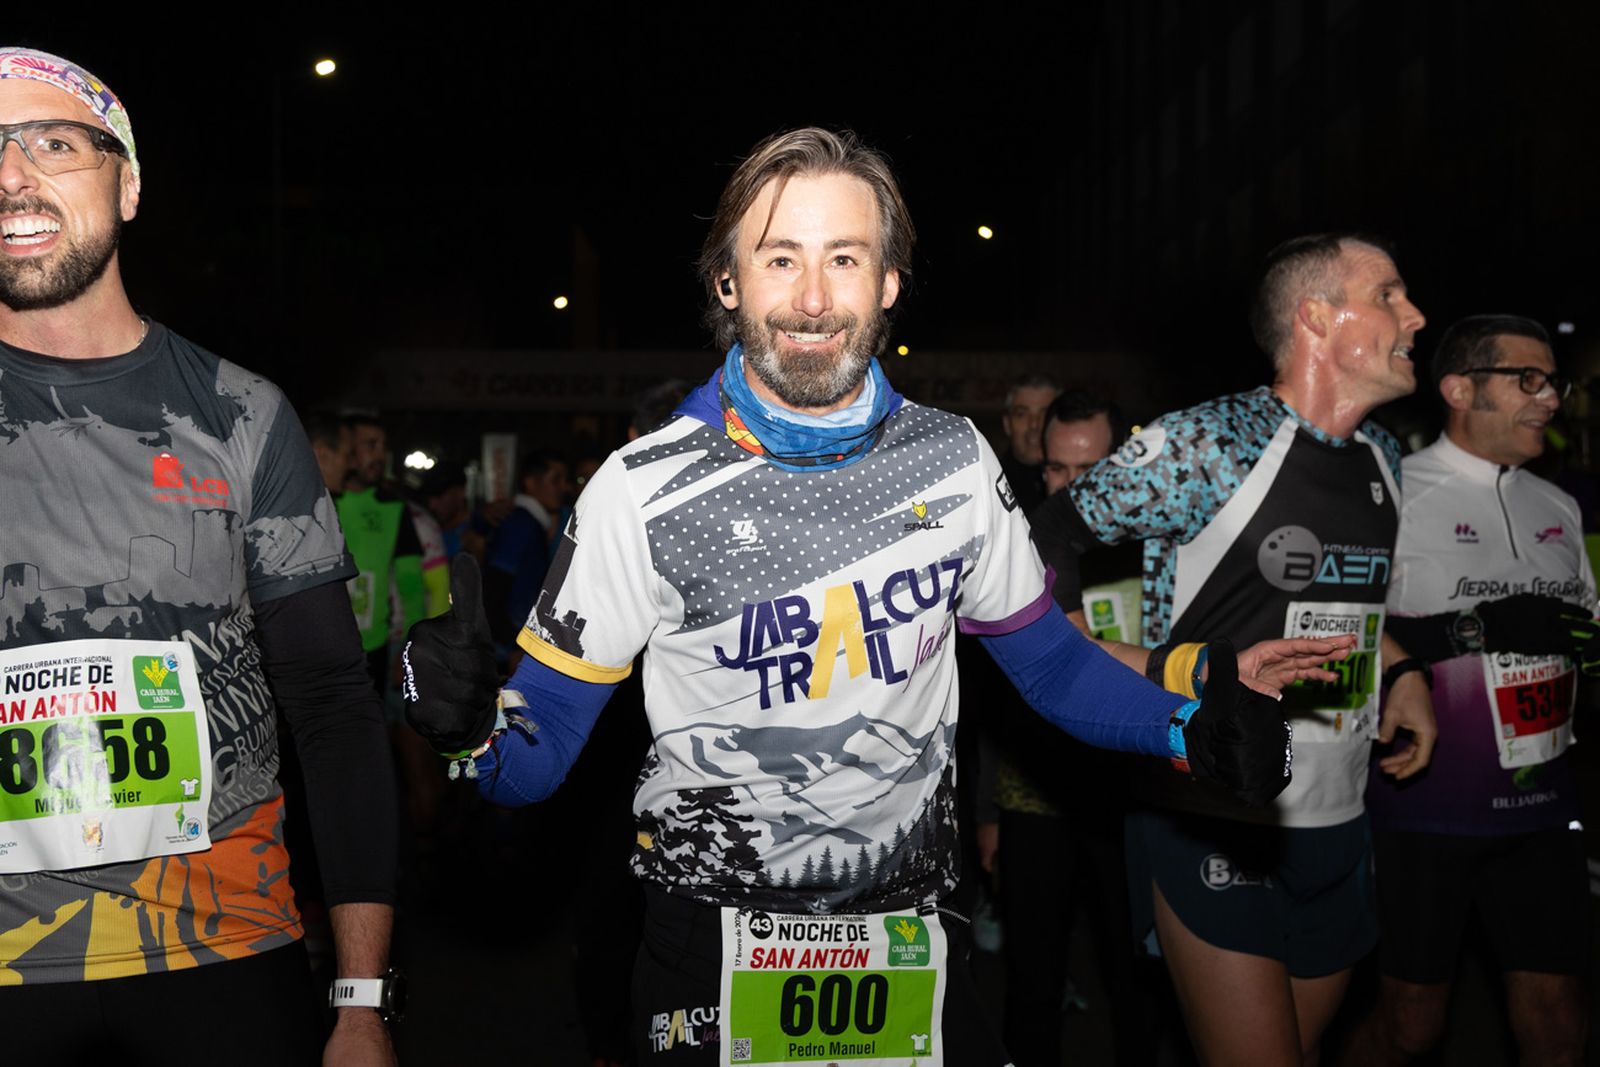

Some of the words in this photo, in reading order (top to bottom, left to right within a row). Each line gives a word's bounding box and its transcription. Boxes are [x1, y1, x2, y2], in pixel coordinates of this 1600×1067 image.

[903, 521, 944, 532] SPALL
[1448, 577, 1509, 600] SIERRA
[1313, 618, 1347, 632] NOCHE
[4, 662, 33, 673] CARRERA
[35, 659, 61, 668] URBANA
[744, 608, 908, 710] TRAIL
[5, 666, 82, 695] NOCHE
[88, 665, 114, 684] DE
[1502, 671, 1527, 685] SAN
[32, 686, 117, 720] ANTÓN
[750, 918, 772, 931] 43
[778, 923, 842, 942] NOCHE
[847, 924, 870, 942] DE
[734, 935, 743, 954] Enero
[734, 956, 741, 967] 17
[750, 947, 793, 969] SAN
[797, 943, 870, 969] ANTÓN
[780, 974, 889, 1037] 600
[788, 1042, 826, 1057] Pedro
[829, 1041, 876, 1056] Manuel
